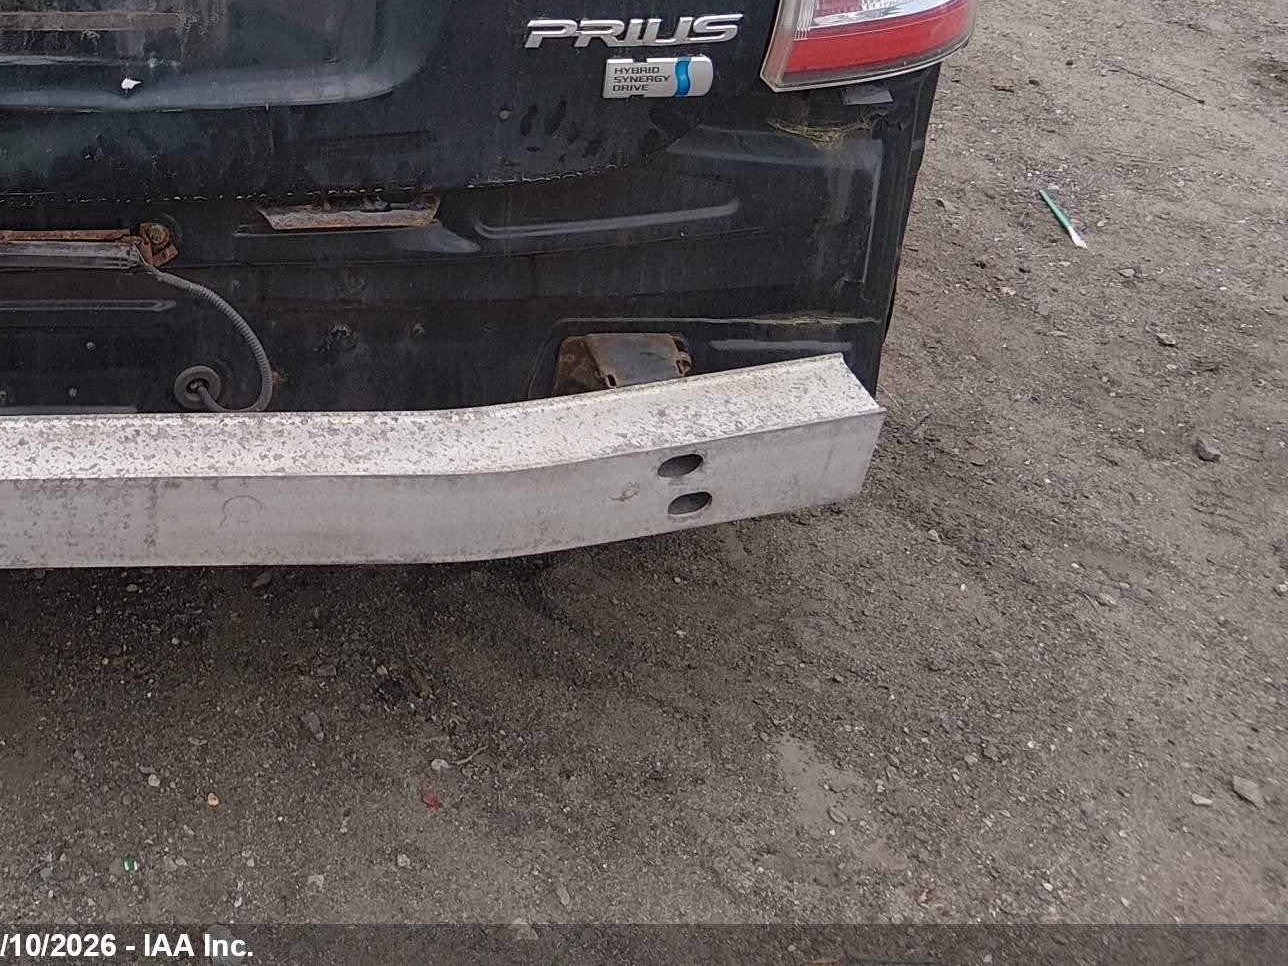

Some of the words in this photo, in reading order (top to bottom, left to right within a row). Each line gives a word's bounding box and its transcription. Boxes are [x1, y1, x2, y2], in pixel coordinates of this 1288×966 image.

[524, 13, 744, 48] PRIUS
[614, 66, 660, 74] HYBRID
[613, 74, 671, 83] SYNERGY
[612, 84, 649, 92] DRIVE
